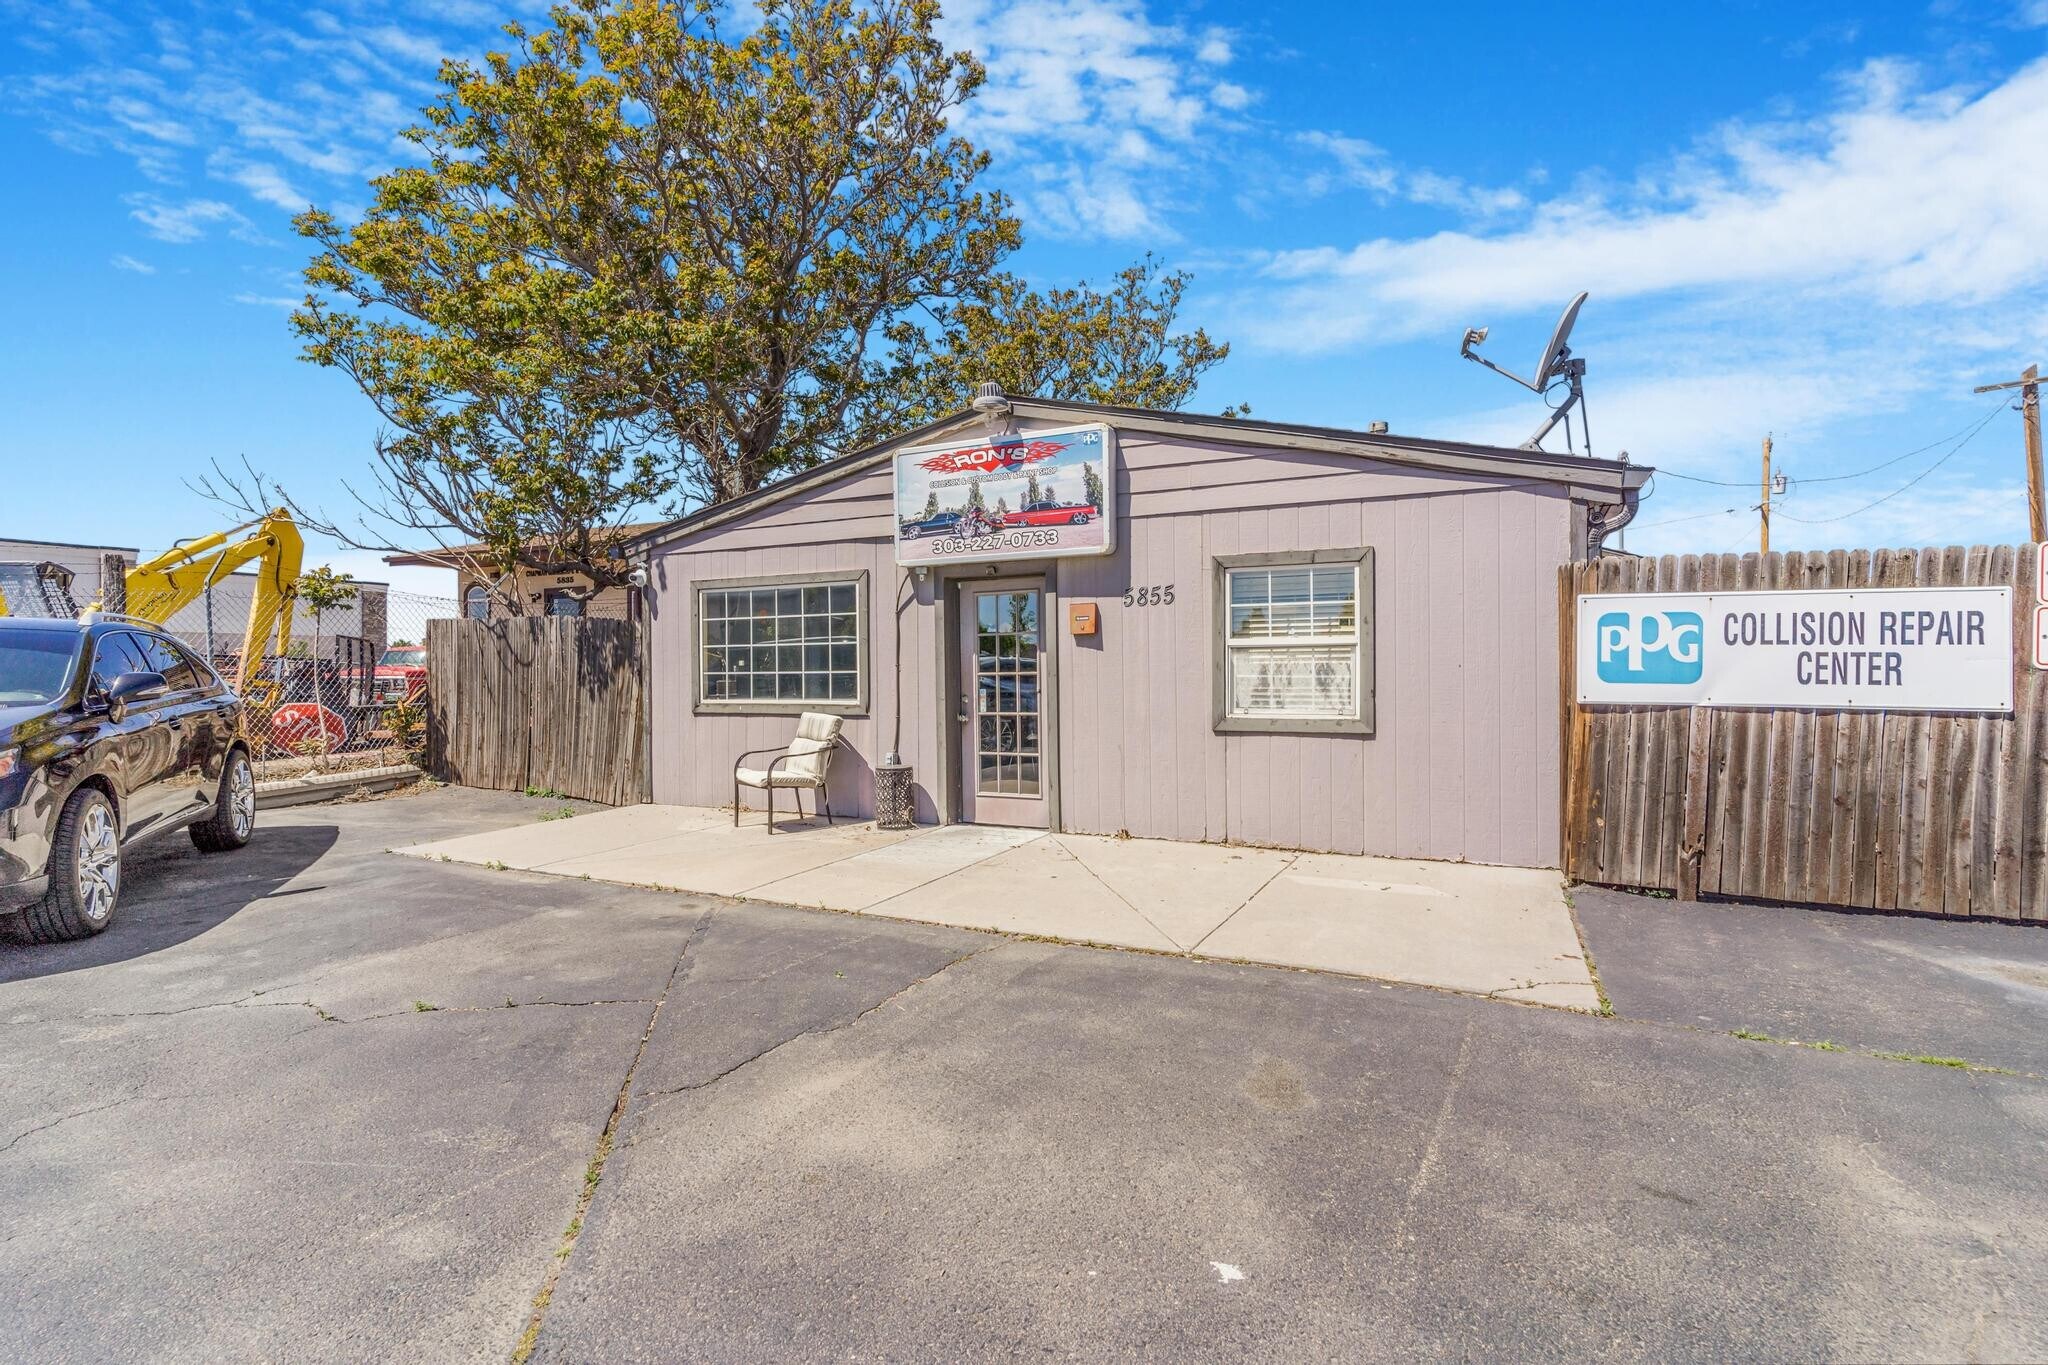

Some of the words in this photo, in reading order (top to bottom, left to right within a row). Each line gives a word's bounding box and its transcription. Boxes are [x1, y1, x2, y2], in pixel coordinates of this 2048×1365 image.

[953, 447, 1029, 468] RON'S
[929, 478, 960, 489] COLLISION
[967, 474, 993, 484] CUSTOM
[994, 472, 1013, 481] BODY
[1018, 468, 1038, 479] PAINT
[1039, 467, 1057, 476] SHOP
[932, 529, 1059, 554] 303-227-0733
[1123, 584, 1175, 607] 5855
[1723, 611, 1865, 646] COLLISION
[1879, 610, 1985, 646] REPAIR
[1797, 651, 1903, 686] CENTER
